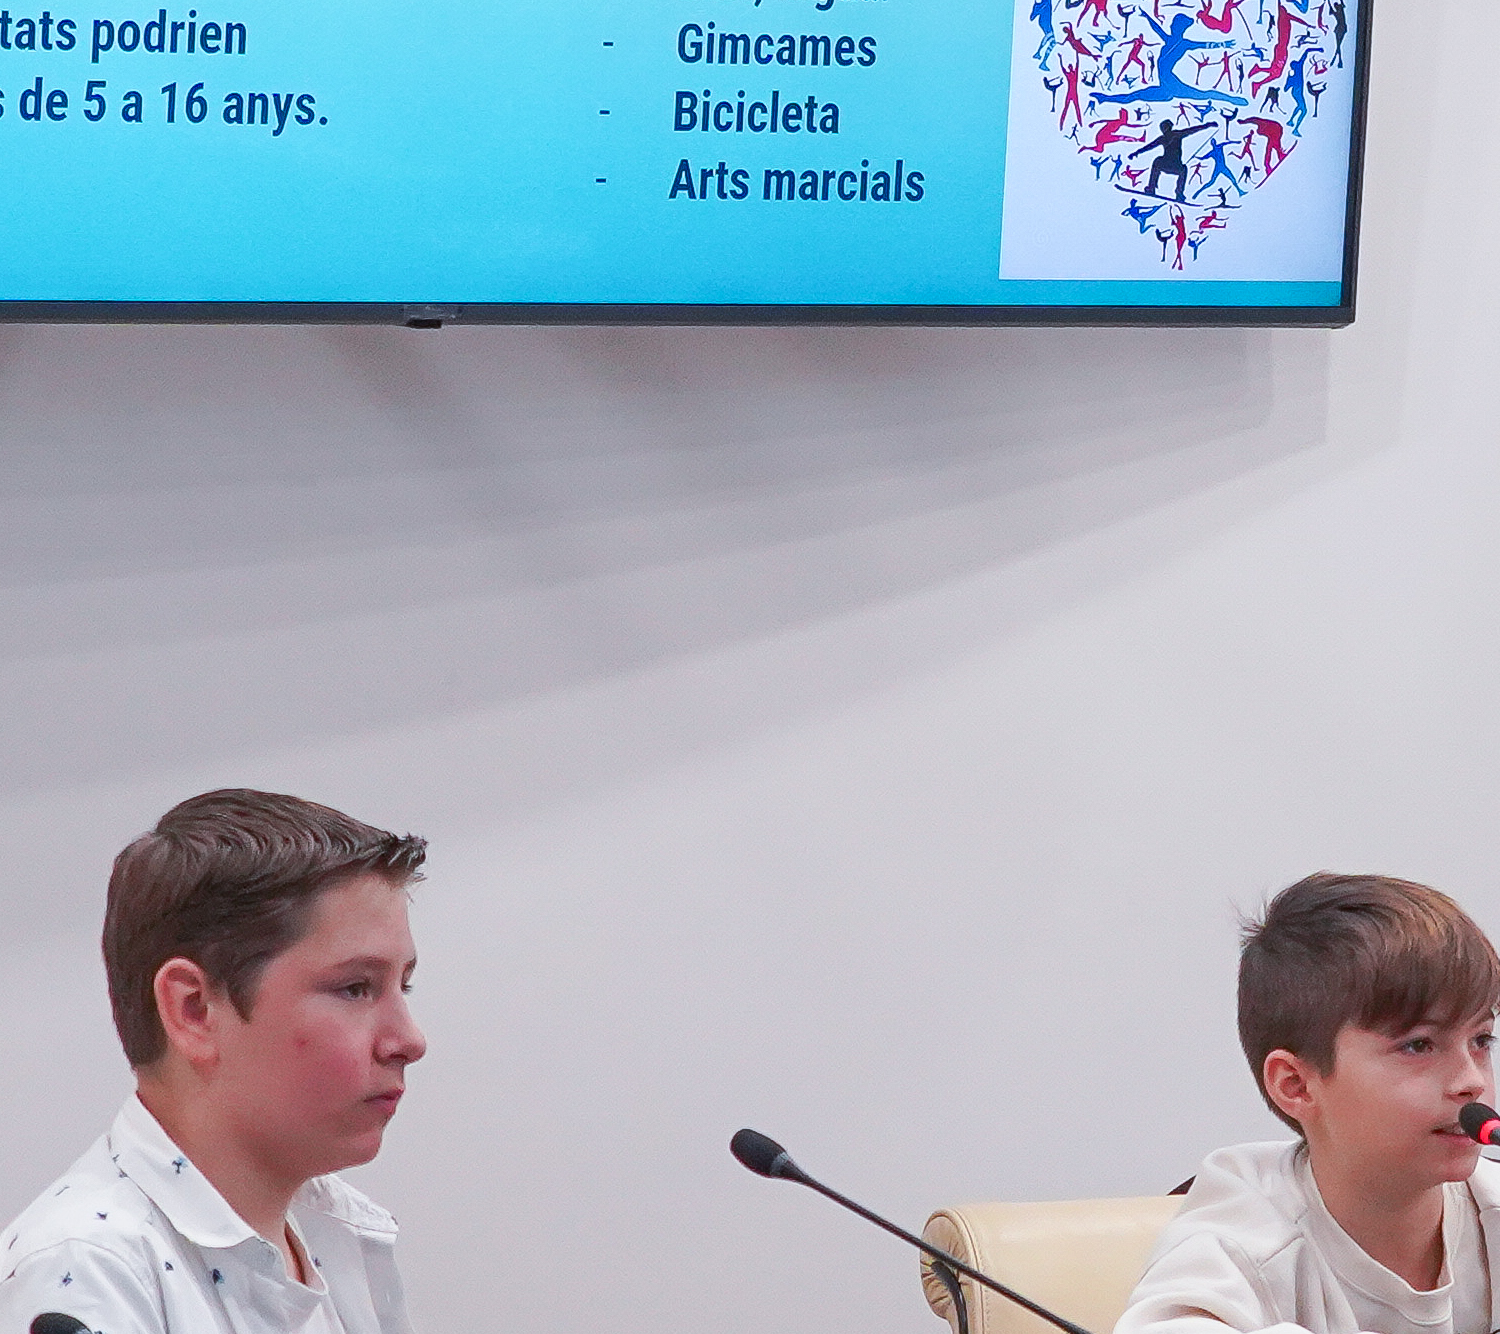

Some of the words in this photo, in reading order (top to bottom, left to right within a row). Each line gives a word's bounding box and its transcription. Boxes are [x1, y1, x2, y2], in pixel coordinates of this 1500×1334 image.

[91, 8, 247, 64] podrien
[677, 20, 877, 67] Gimcames
[19, 76, 69, 122] de
[83, 79, 107, 122] 5
[121, 90, 143, 124] a
[160, 81, 208, 124] 16
[222, 92, 328, 137] anys.
[673, 88, 840, 135] Bicicleta
[668, 158, 750, 200] Arts
[762, 158, 925, 202] marcials
